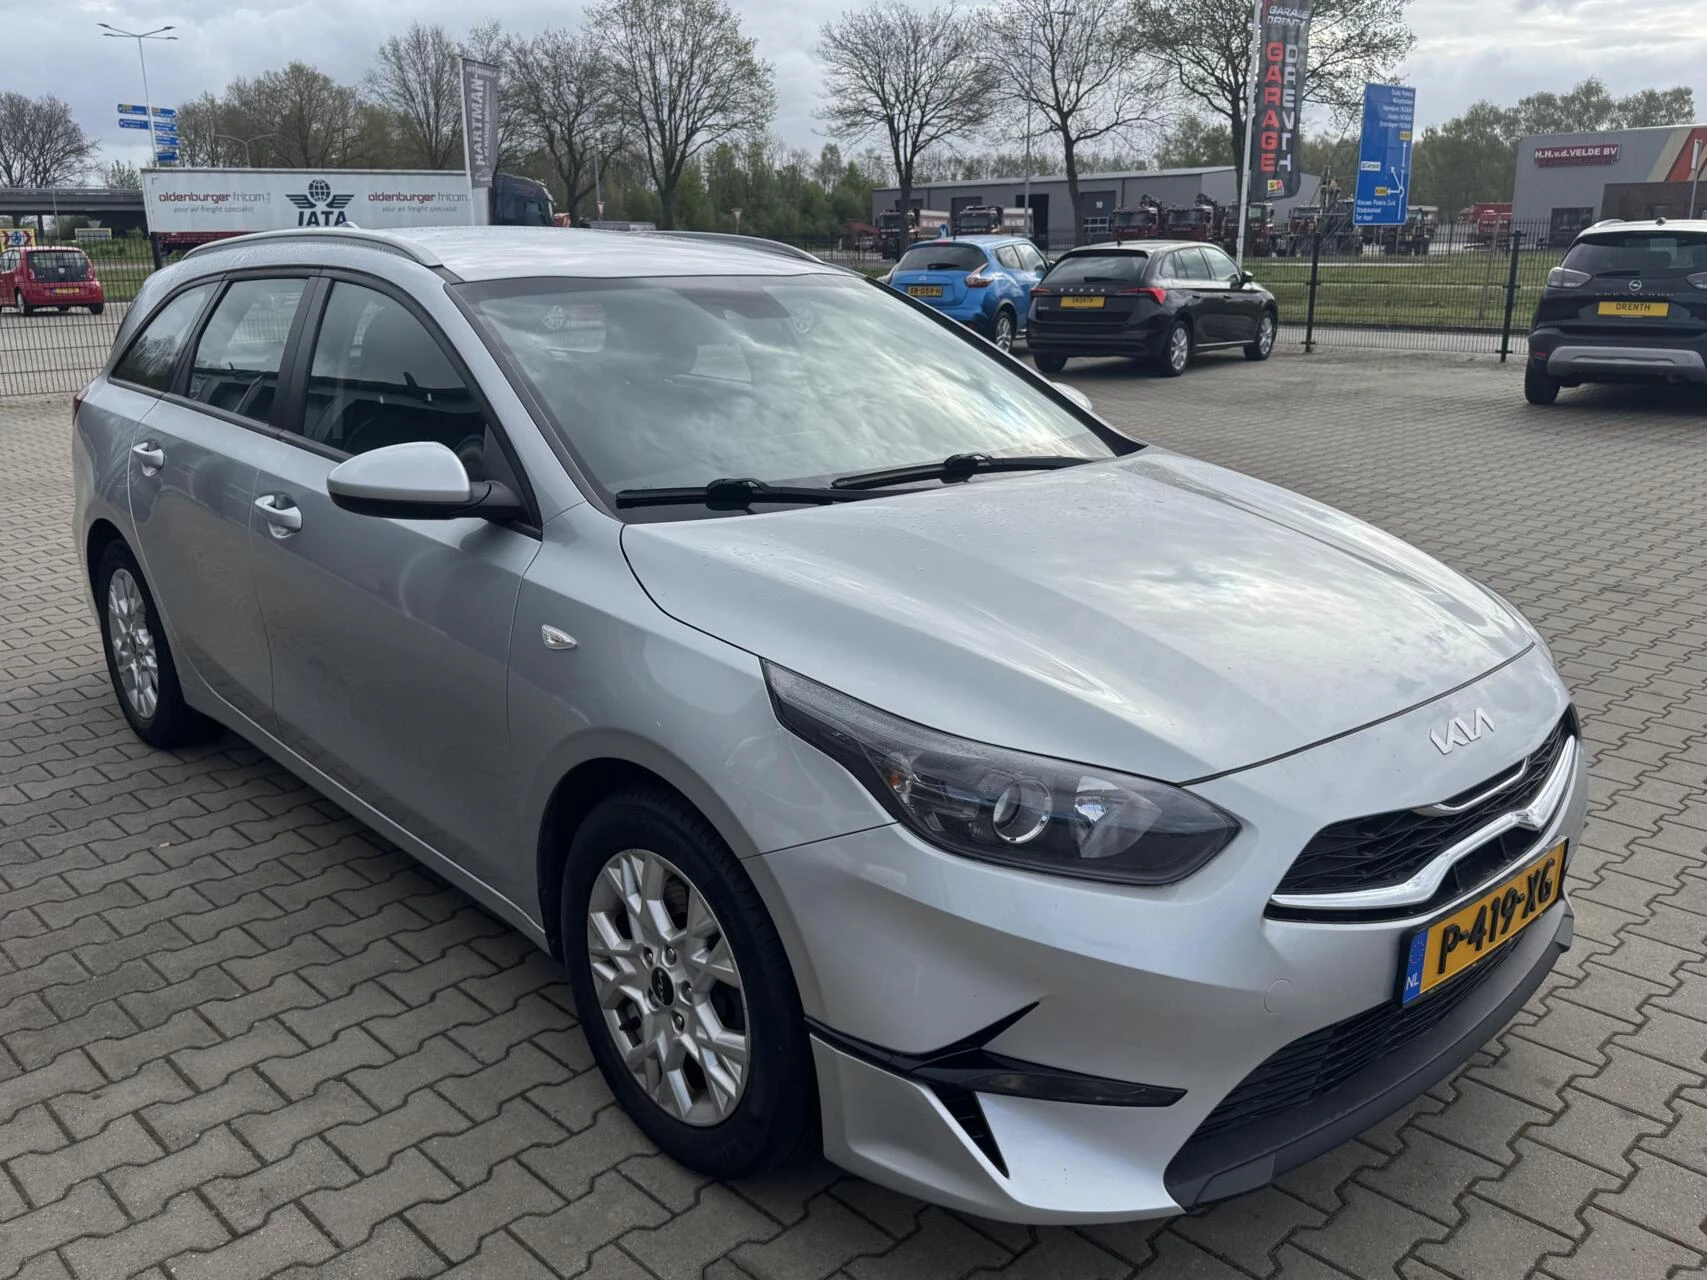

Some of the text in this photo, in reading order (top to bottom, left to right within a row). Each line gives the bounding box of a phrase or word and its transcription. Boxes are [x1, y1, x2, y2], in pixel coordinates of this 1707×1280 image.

[1260, 41, 1285, 172] GARAGE
[470, 78, 486, 166] HARTMAN
[1603, 147, 1617, 155] BV
[158, 192, 231, 204] oldenburger
[368, 192, 435, 204] oldenburger
[190, 205, 199, 213] air
[201, 204, 223, 214] freight
[224, 205, 254, 214] specialist
[407, 205, 428, 213] freight
[298, 210, 348, 227] IATA
[1615, 302, 1651, 311] DRENTH
[1437, 858, 1556, 975] P-419-XG
[1405, 973, 1420, 990] NL
